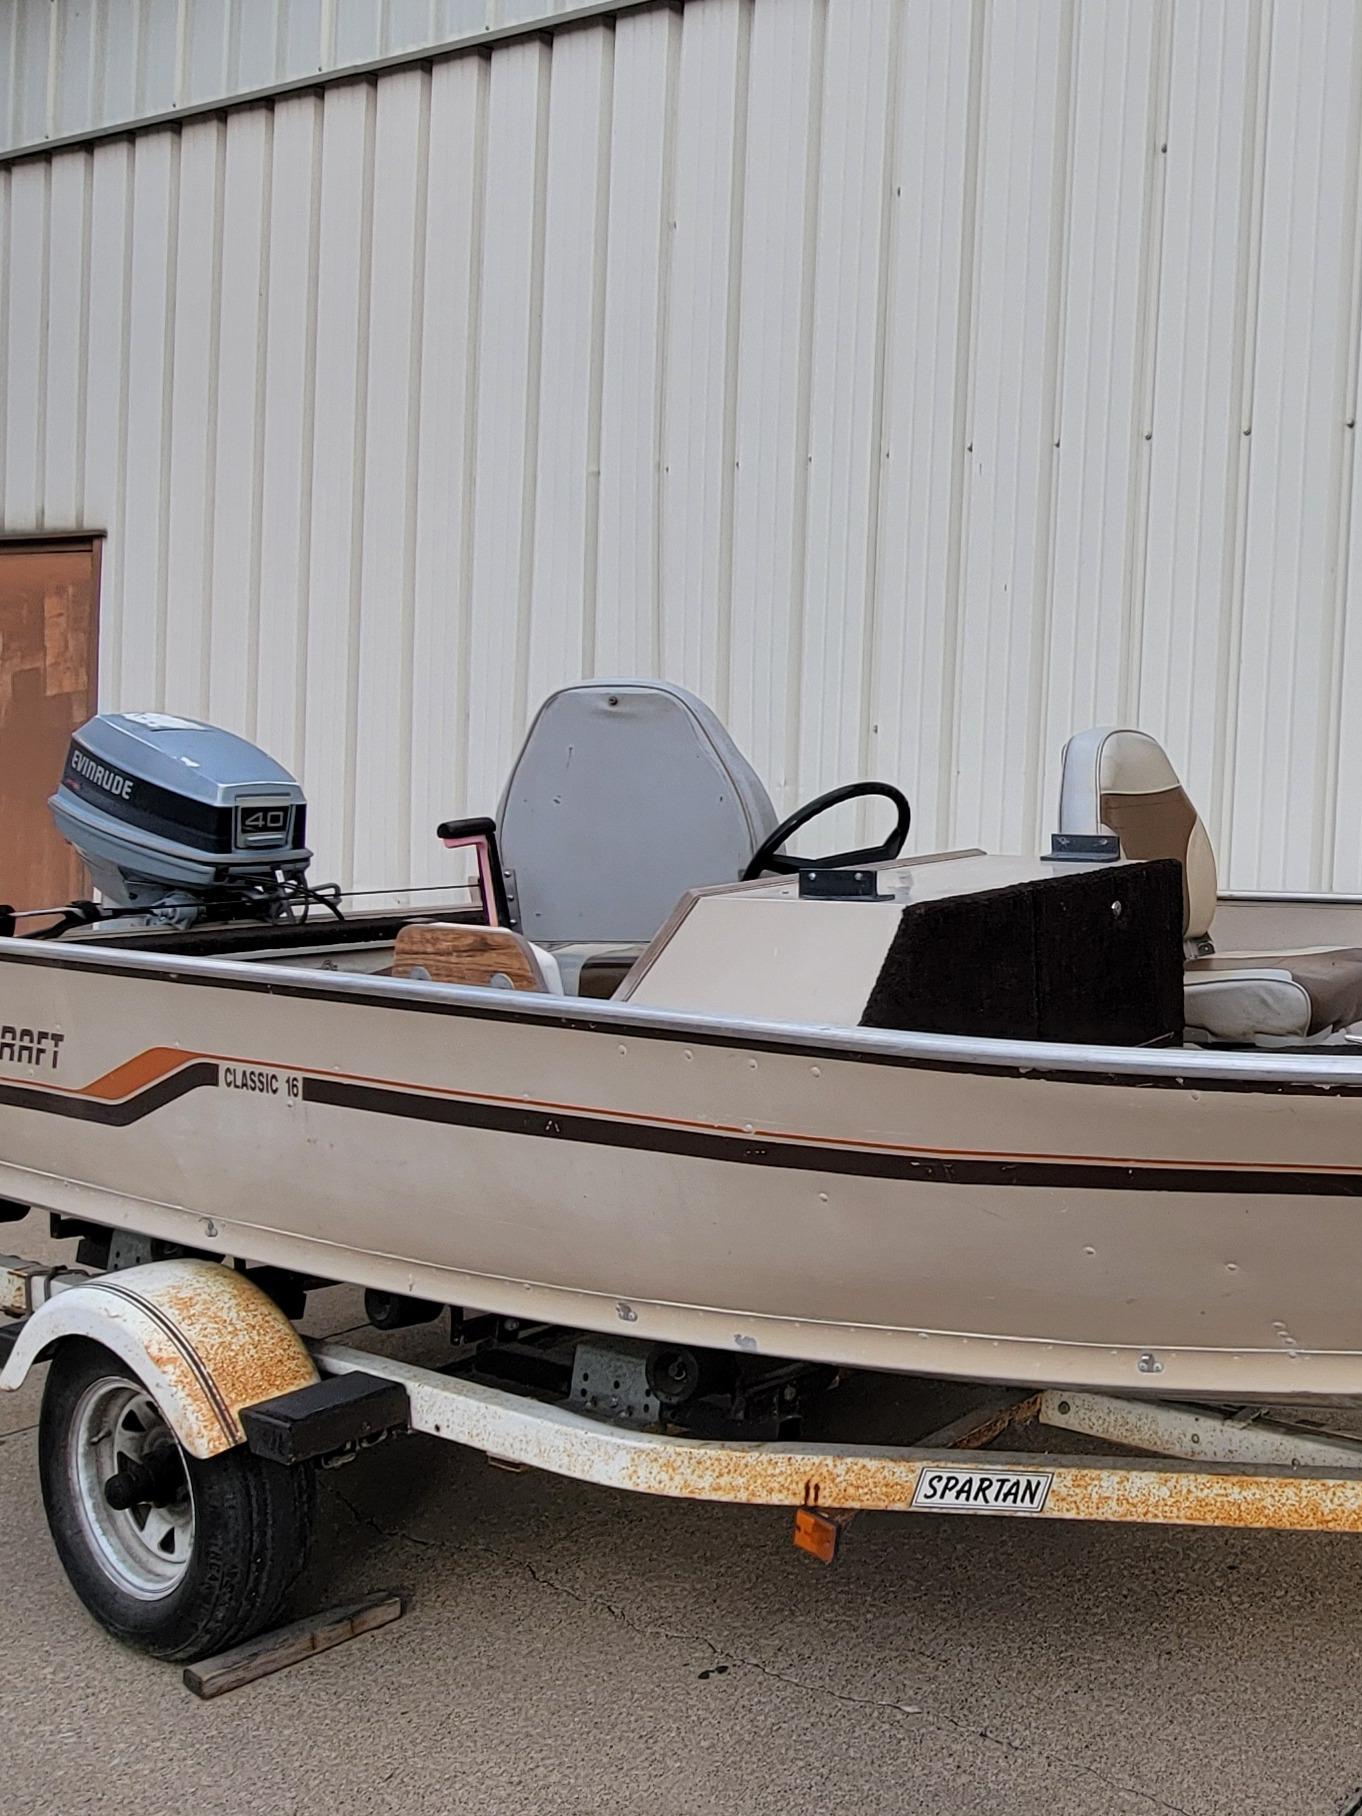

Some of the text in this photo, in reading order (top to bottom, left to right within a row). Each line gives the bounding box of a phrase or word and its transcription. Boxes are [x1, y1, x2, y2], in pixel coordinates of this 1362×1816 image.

[71, 750, 134, 800] EVINRUDE
[245, 811, 284, 828] 40
[0, 1025, 64, 1069] RAFT
[224, 1066, 299, 1098] CLASSIC 16
[923, 1475, 1041, 1505] SPARTAN
